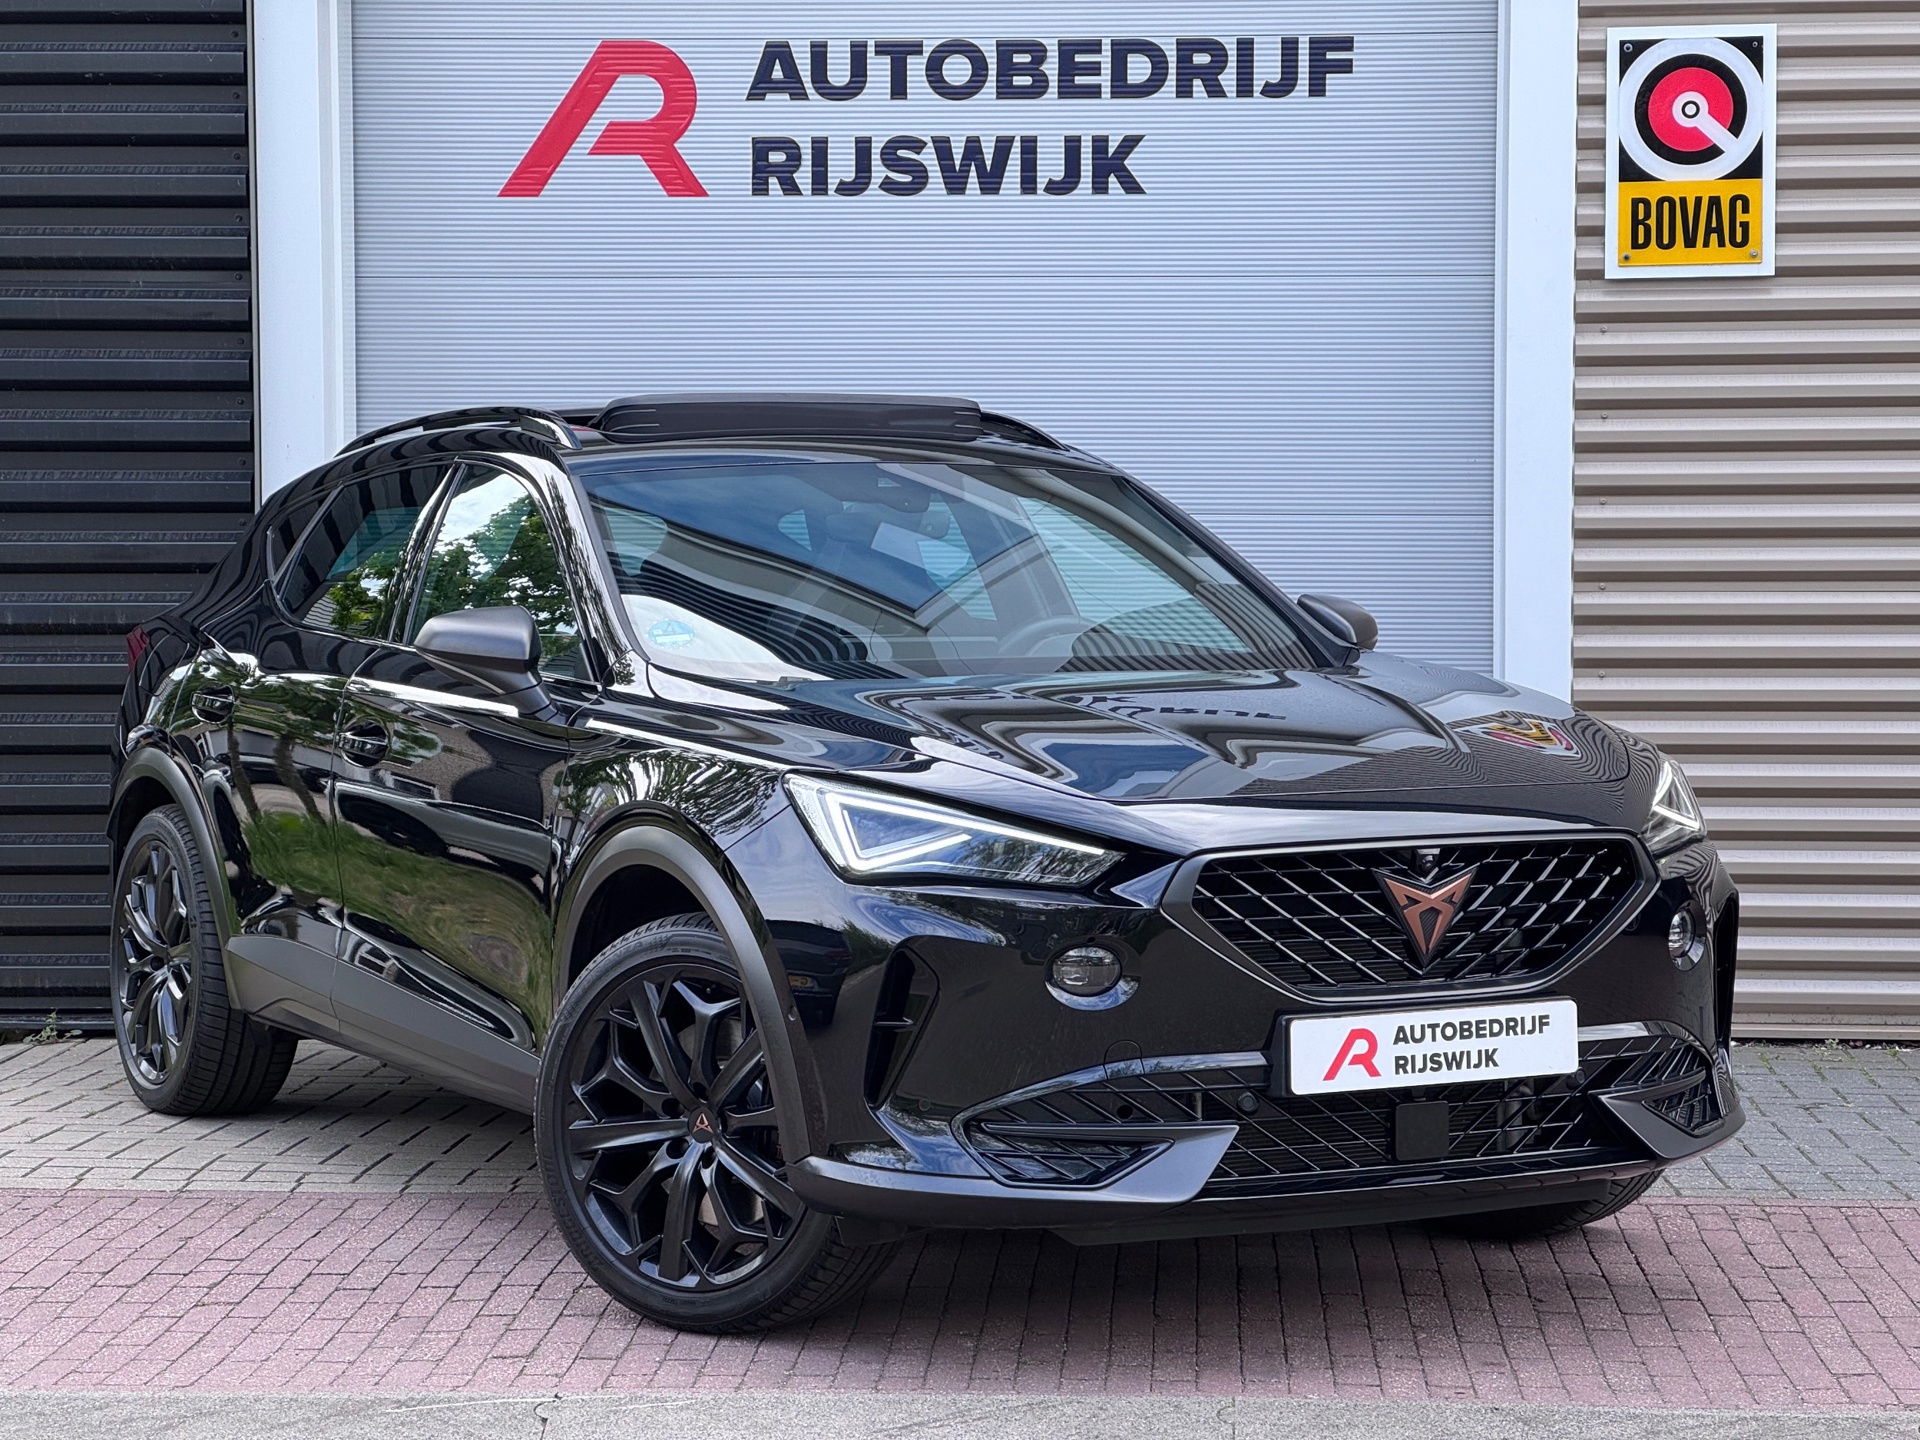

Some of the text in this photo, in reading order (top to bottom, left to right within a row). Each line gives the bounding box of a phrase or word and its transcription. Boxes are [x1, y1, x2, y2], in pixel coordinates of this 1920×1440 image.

[746, 35, 1354, 102] AUTOBEDRIJF
[751, 134, 1147, 197] RIJSWIJK
[1631, 193, 1750, 251] BOVAG
[1392, 1014, 1550, 1046] AUTOBEDRIJF
[1394, 1047, 1500, 1076] RIJSWIJK
